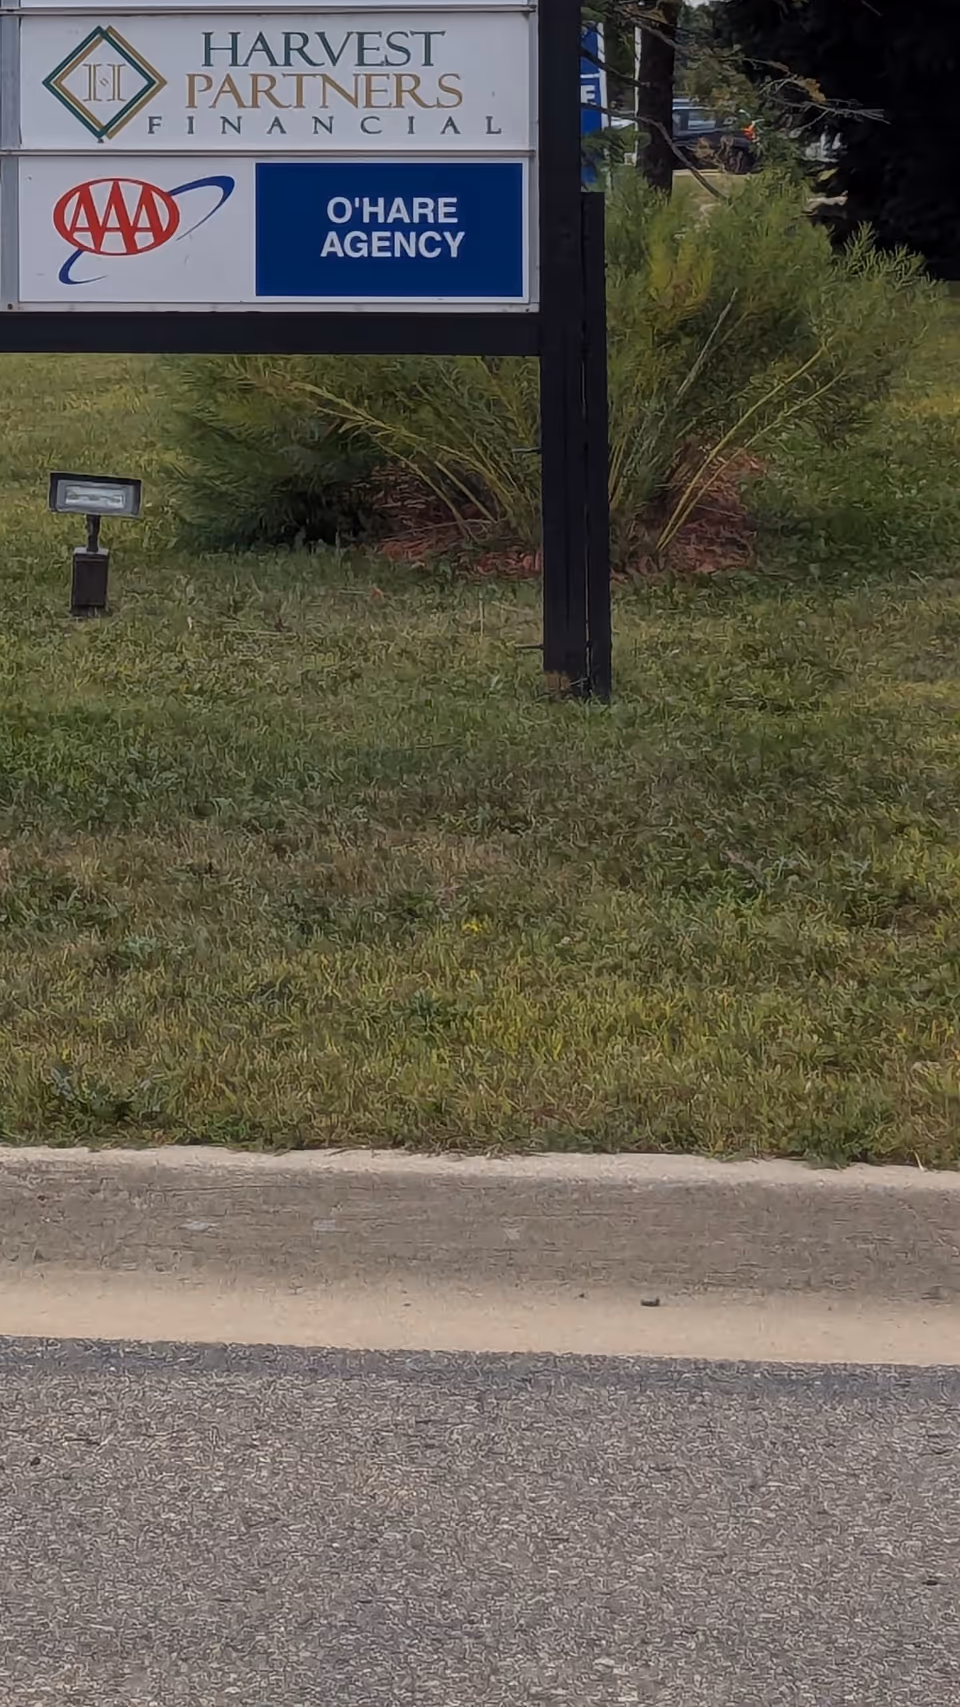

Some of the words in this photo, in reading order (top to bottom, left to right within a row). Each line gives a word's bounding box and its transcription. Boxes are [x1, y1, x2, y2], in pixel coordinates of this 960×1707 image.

[202, 31, 445, 67] HARVEST
[186, 73, 462, 108] PARTNERS
[148, 116, 501, 134] FINANCIAL
[67, 179, 170, 255] AAA
[327, 197, 458, 223] O'HARE
[321, 231, 465, 258] AGENCY
